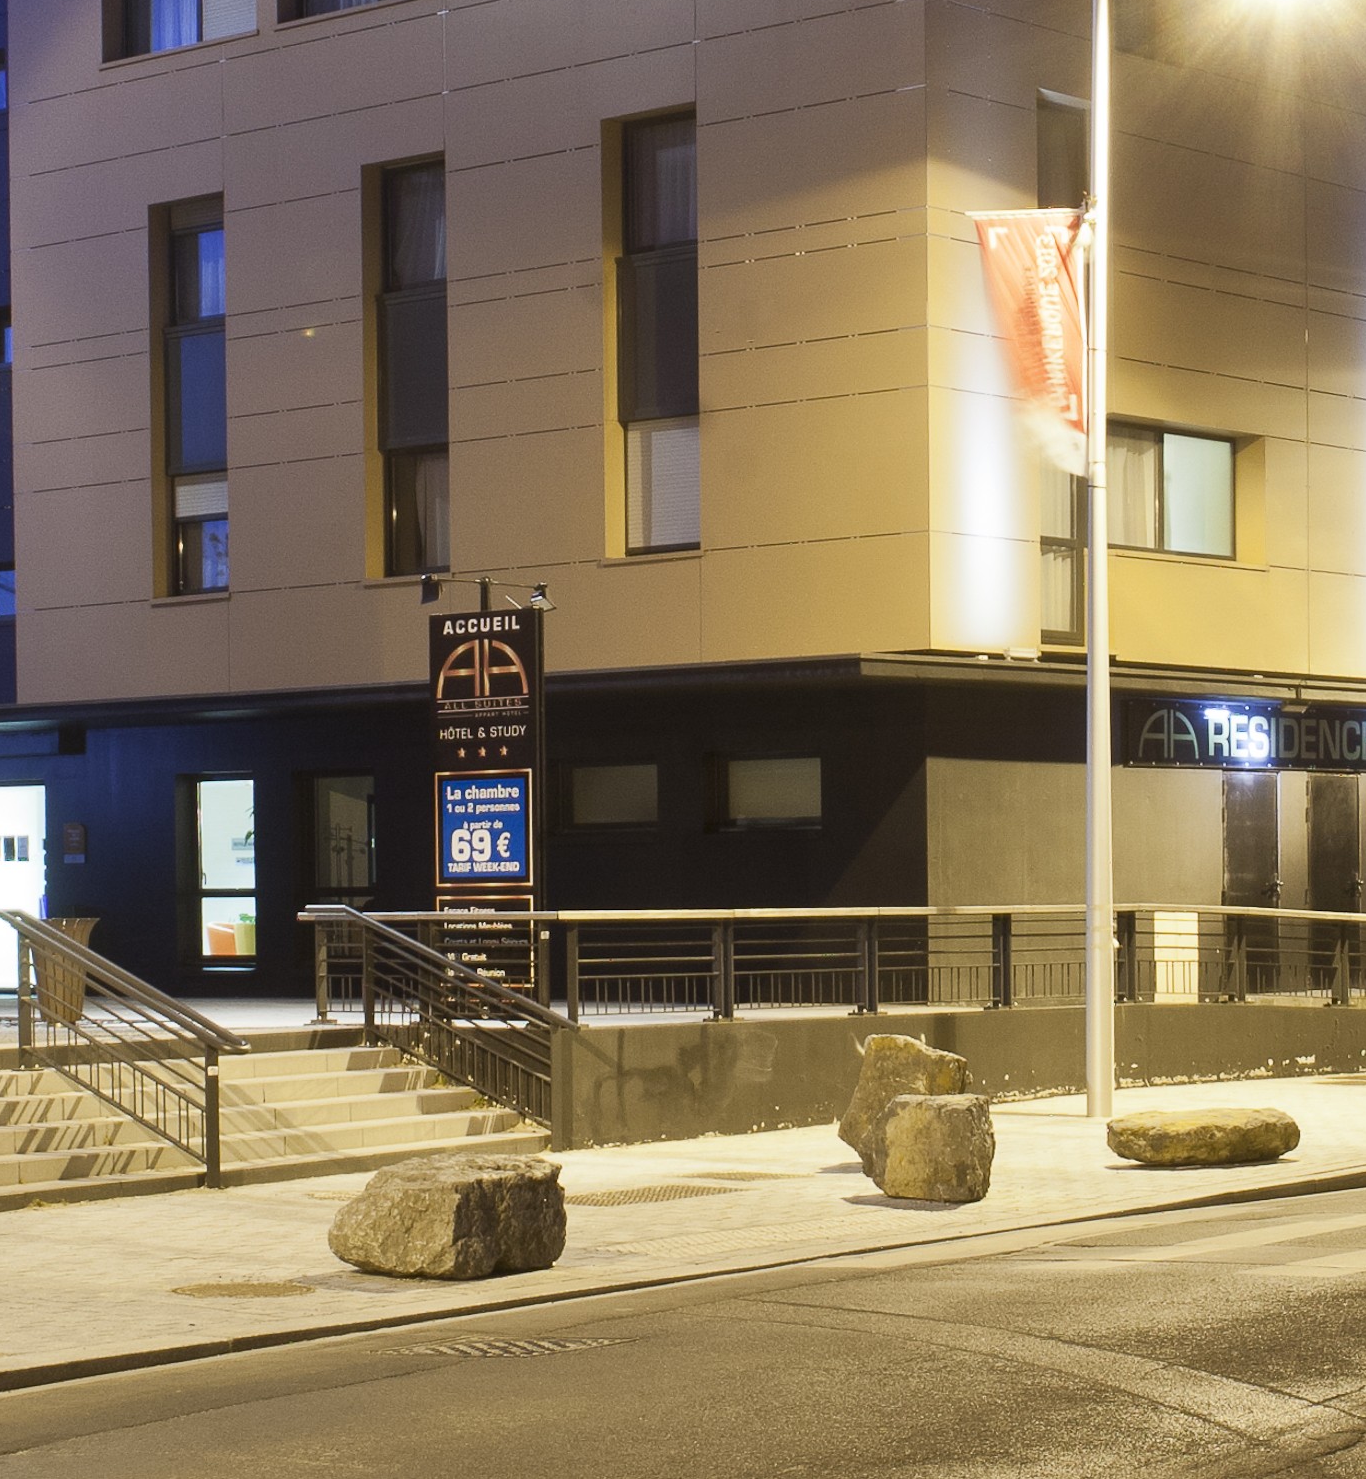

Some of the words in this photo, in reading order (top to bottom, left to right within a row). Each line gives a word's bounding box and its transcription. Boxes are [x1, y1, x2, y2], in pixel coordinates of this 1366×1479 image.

[443, 615, 521, 636] ACCUEIL
[444, 701, 468, 711] ALL
[475, 698, 522, 709] SUITES
[439, 725, 473, 740] HÔTEL
[477, 726, 486, 738] &
[490, 725, 526, 738] STUDY
[446, 786, 461, 801] La
[465, 784, 520, 800] chambre
[446, 803, 453, 813] 1
[454, 805, 465, 813] ou
[467, 802, 474, 813] 2
[475, 803, 520, 815] personnes
[469, 819, 492, 832] partir
[493, 819, 503, 829] de
[451, 828, 492, 862] 69
[497, 831, 511, 858] €
[448, 862, 472, 873] TARIF
[473, 861, 520, 872] WEEK-END
[476, 967, 506, 977] Réunion
